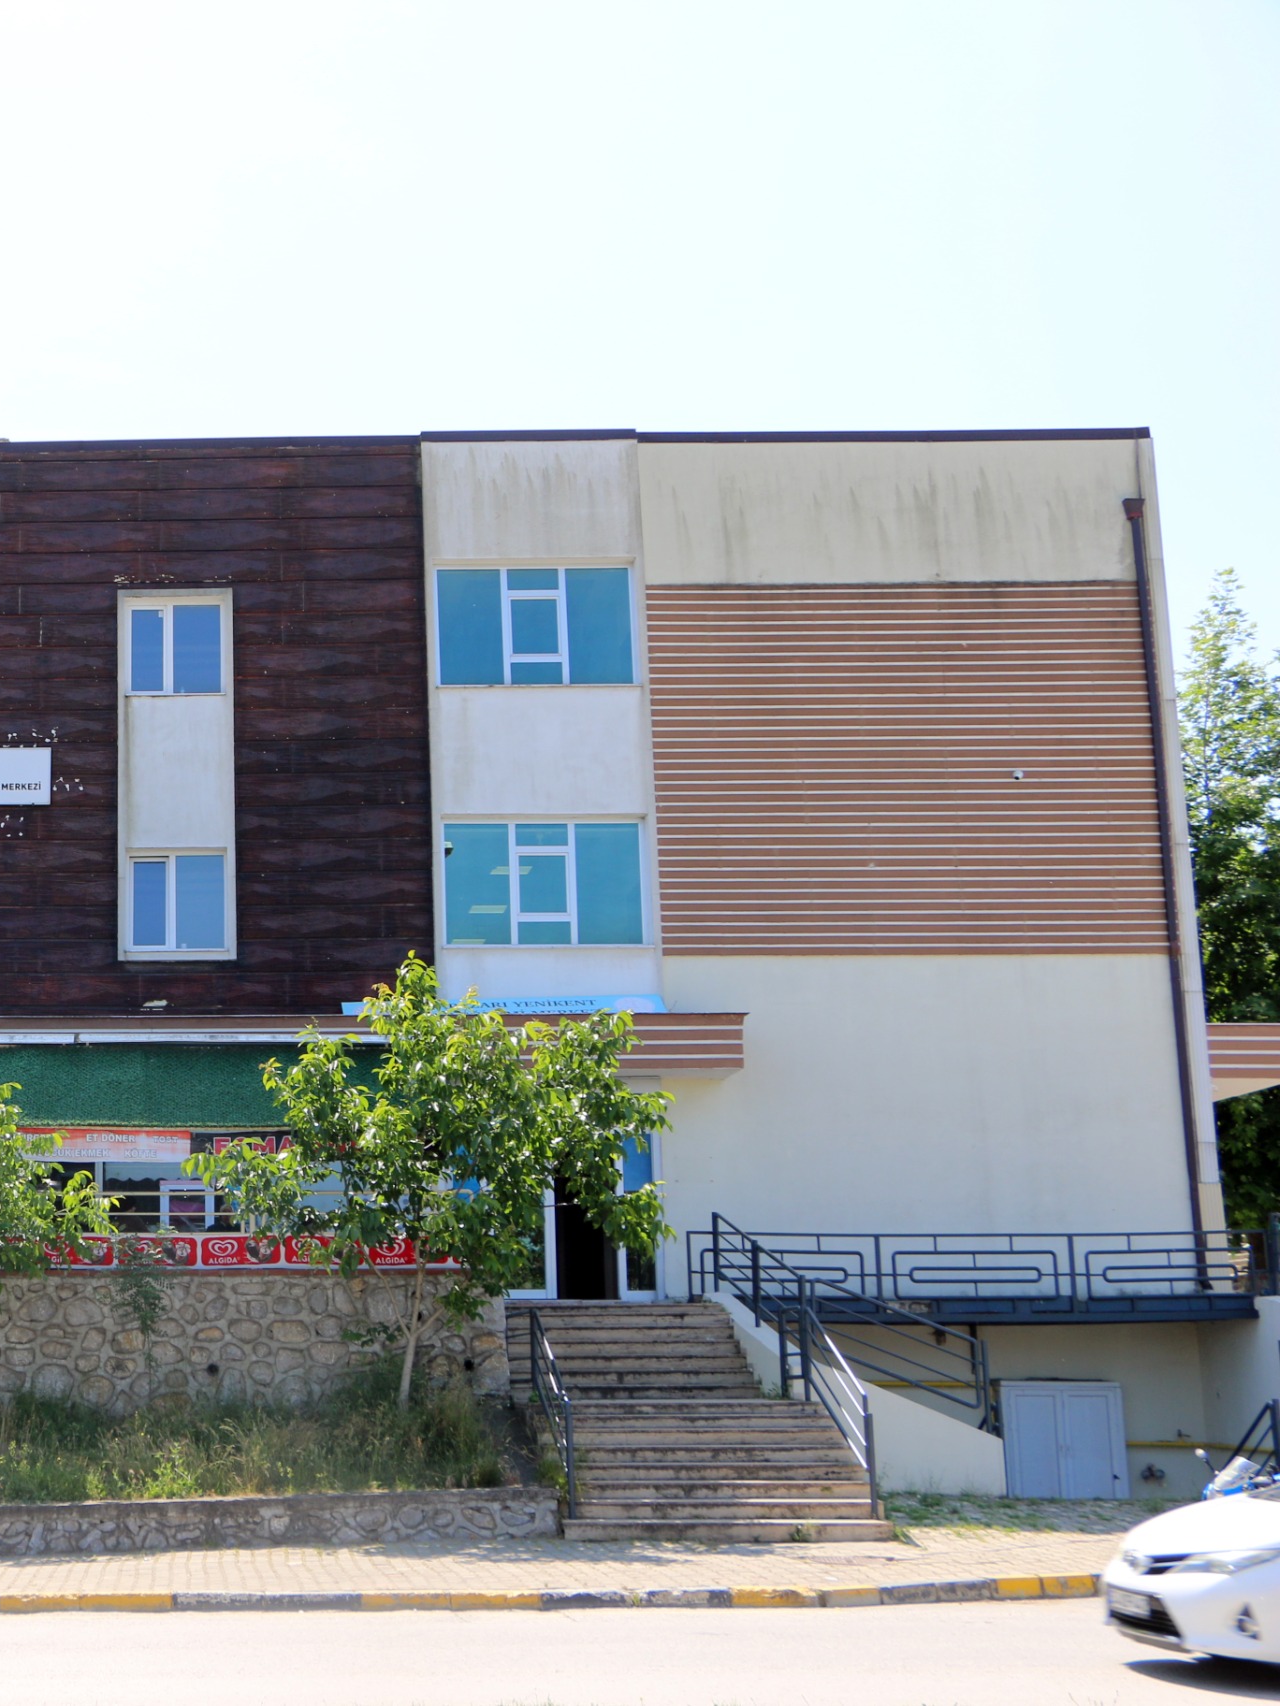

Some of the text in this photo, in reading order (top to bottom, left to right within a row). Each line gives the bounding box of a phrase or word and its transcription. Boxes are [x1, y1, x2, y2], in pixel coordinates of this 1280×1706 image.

[1, 781, 42, 791] MERKEZİ
[513, 998, 597, 1008] YENİKENT
[86, 1133, 99, 1143] ET
[153, 1135, 179, 1144] TOST
[75, 1148, 111, 1158] EKMEK
